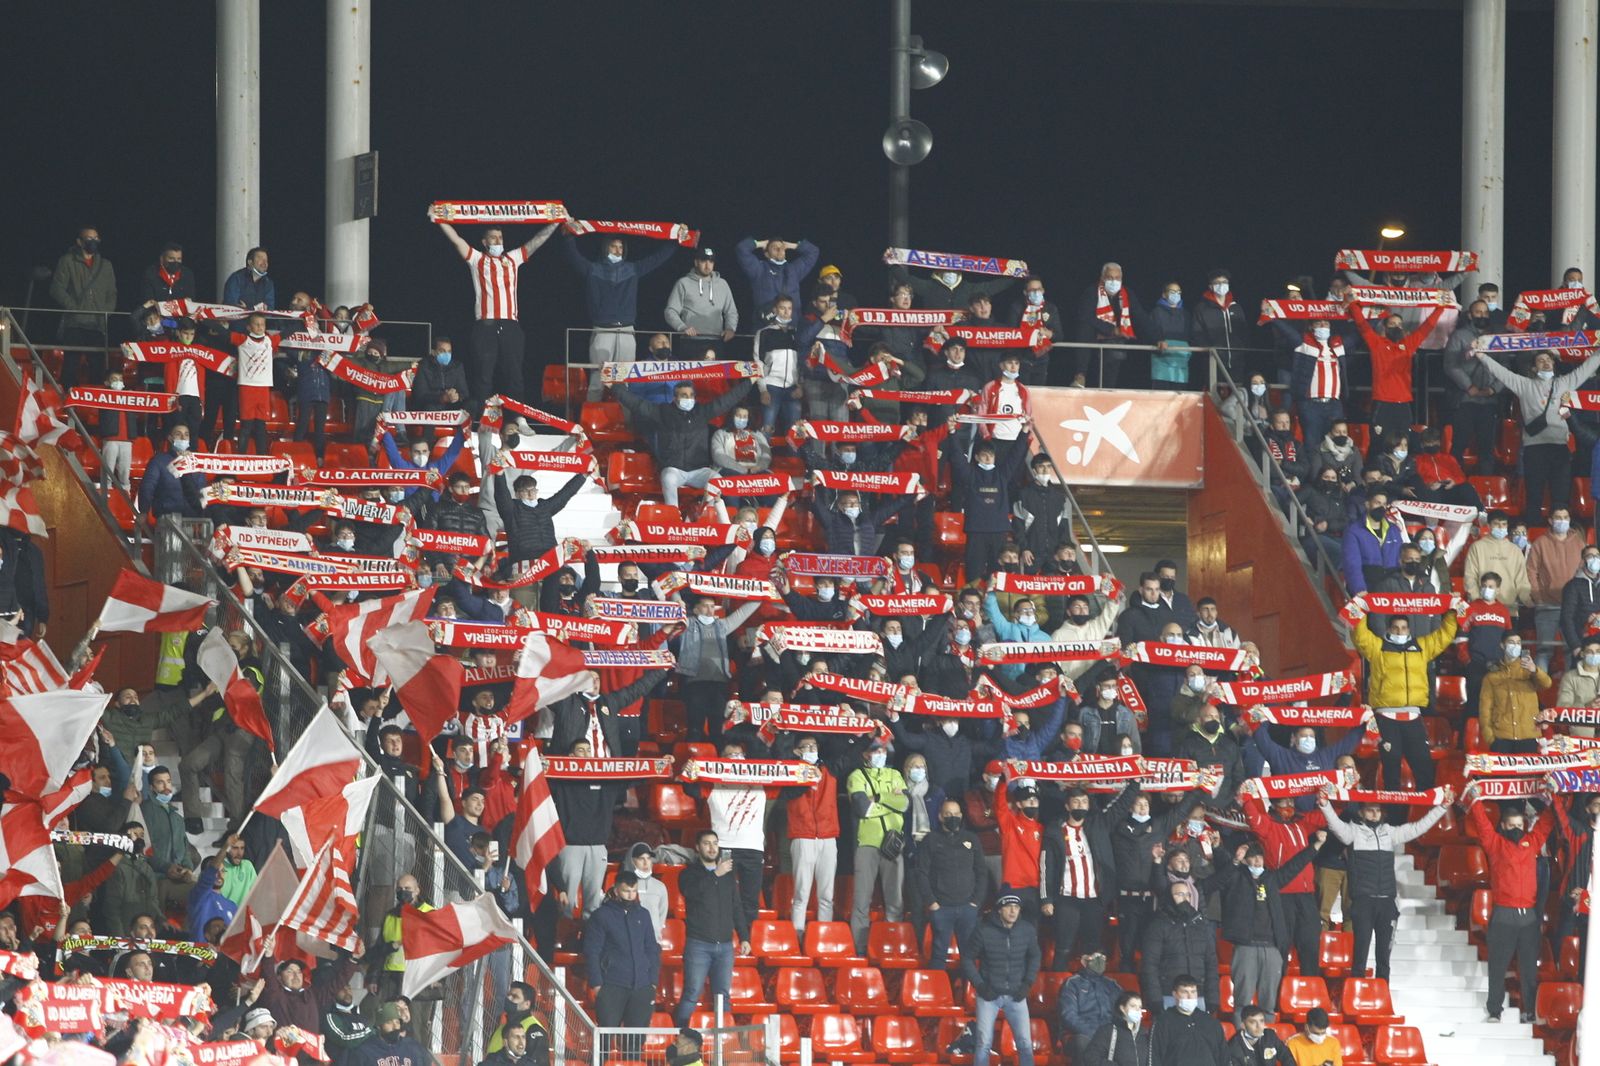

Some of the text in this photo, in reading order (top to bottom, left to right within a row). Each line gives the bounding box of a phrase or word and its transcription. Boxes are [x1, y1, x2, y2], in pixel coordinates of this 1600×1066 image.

[460, 201, 540, 216] UD ALMERÍA
[616, 221, 662, 232] ALMERÍA
[1373, 254, 1441, 264] UD ALMERÍA
[1360, 289, 1380, 299] UD
[1525, 289, 1585, 304] UD ALMERÍA
[1288, 303, 1345, 313] UD ALMER
[957, 330, 1022, 340] UD ALMERÍA
[150, 345, 214, 362] UD ALMERÍA
[346, 367, 398, 390] ALMERÍA UD
[648, 372, 724, 381] ORGULLO ROJIBLANCO
[822, 425, 839, 434] UD
[520, 454, 582, 465] UD ALMERÍA
[718, 477, 780, 488] UD ALMERÍA
[831, 472, 899, 486] UD ALMERÍA
[236, 487, 255, 498] UD
[647, 526, 718, 537] UD ALMERÍA
[419, 532, 479, 548] UD ALMERÍA
[685, 573, 704, 586] UD
[1015, 580, 1085, 591] ALMERÍA UD
[867, 597, 937, 607] UD ALMERÍA
[1372, 596, 1441, 607] UD ALMERÍA
[1476, 614, 1504, 624] adidas
[547, 619, 611, 635] UD ALMERÍA
[464, 632, 516, 643] ALMERÍA
[566, 631, 593, 639] 001-2021
[1005, 646, 1026, 659] UD
[1155, 648, 1226, 662] UD ALMERÍA
[465, 665, 516, 682] ALMER
[813, 674, 835, 685] UD
[1241, 680, 1313, 696] UD ALMERÍA
[924, 699, 994, 713] ALMERÍA UD
[1281, 708, 1353, 719] UD ALMERÍA
[1498, 756, 1517, 767] UD
[705, 760, 790, 777] UD ALMERÍA
[1270, 779, 1286, 789] UD
[1485, 783, 1503, 795] UD
[54, 985, 67, 1000] UD
[200, 1048, 215, 1062] UD
